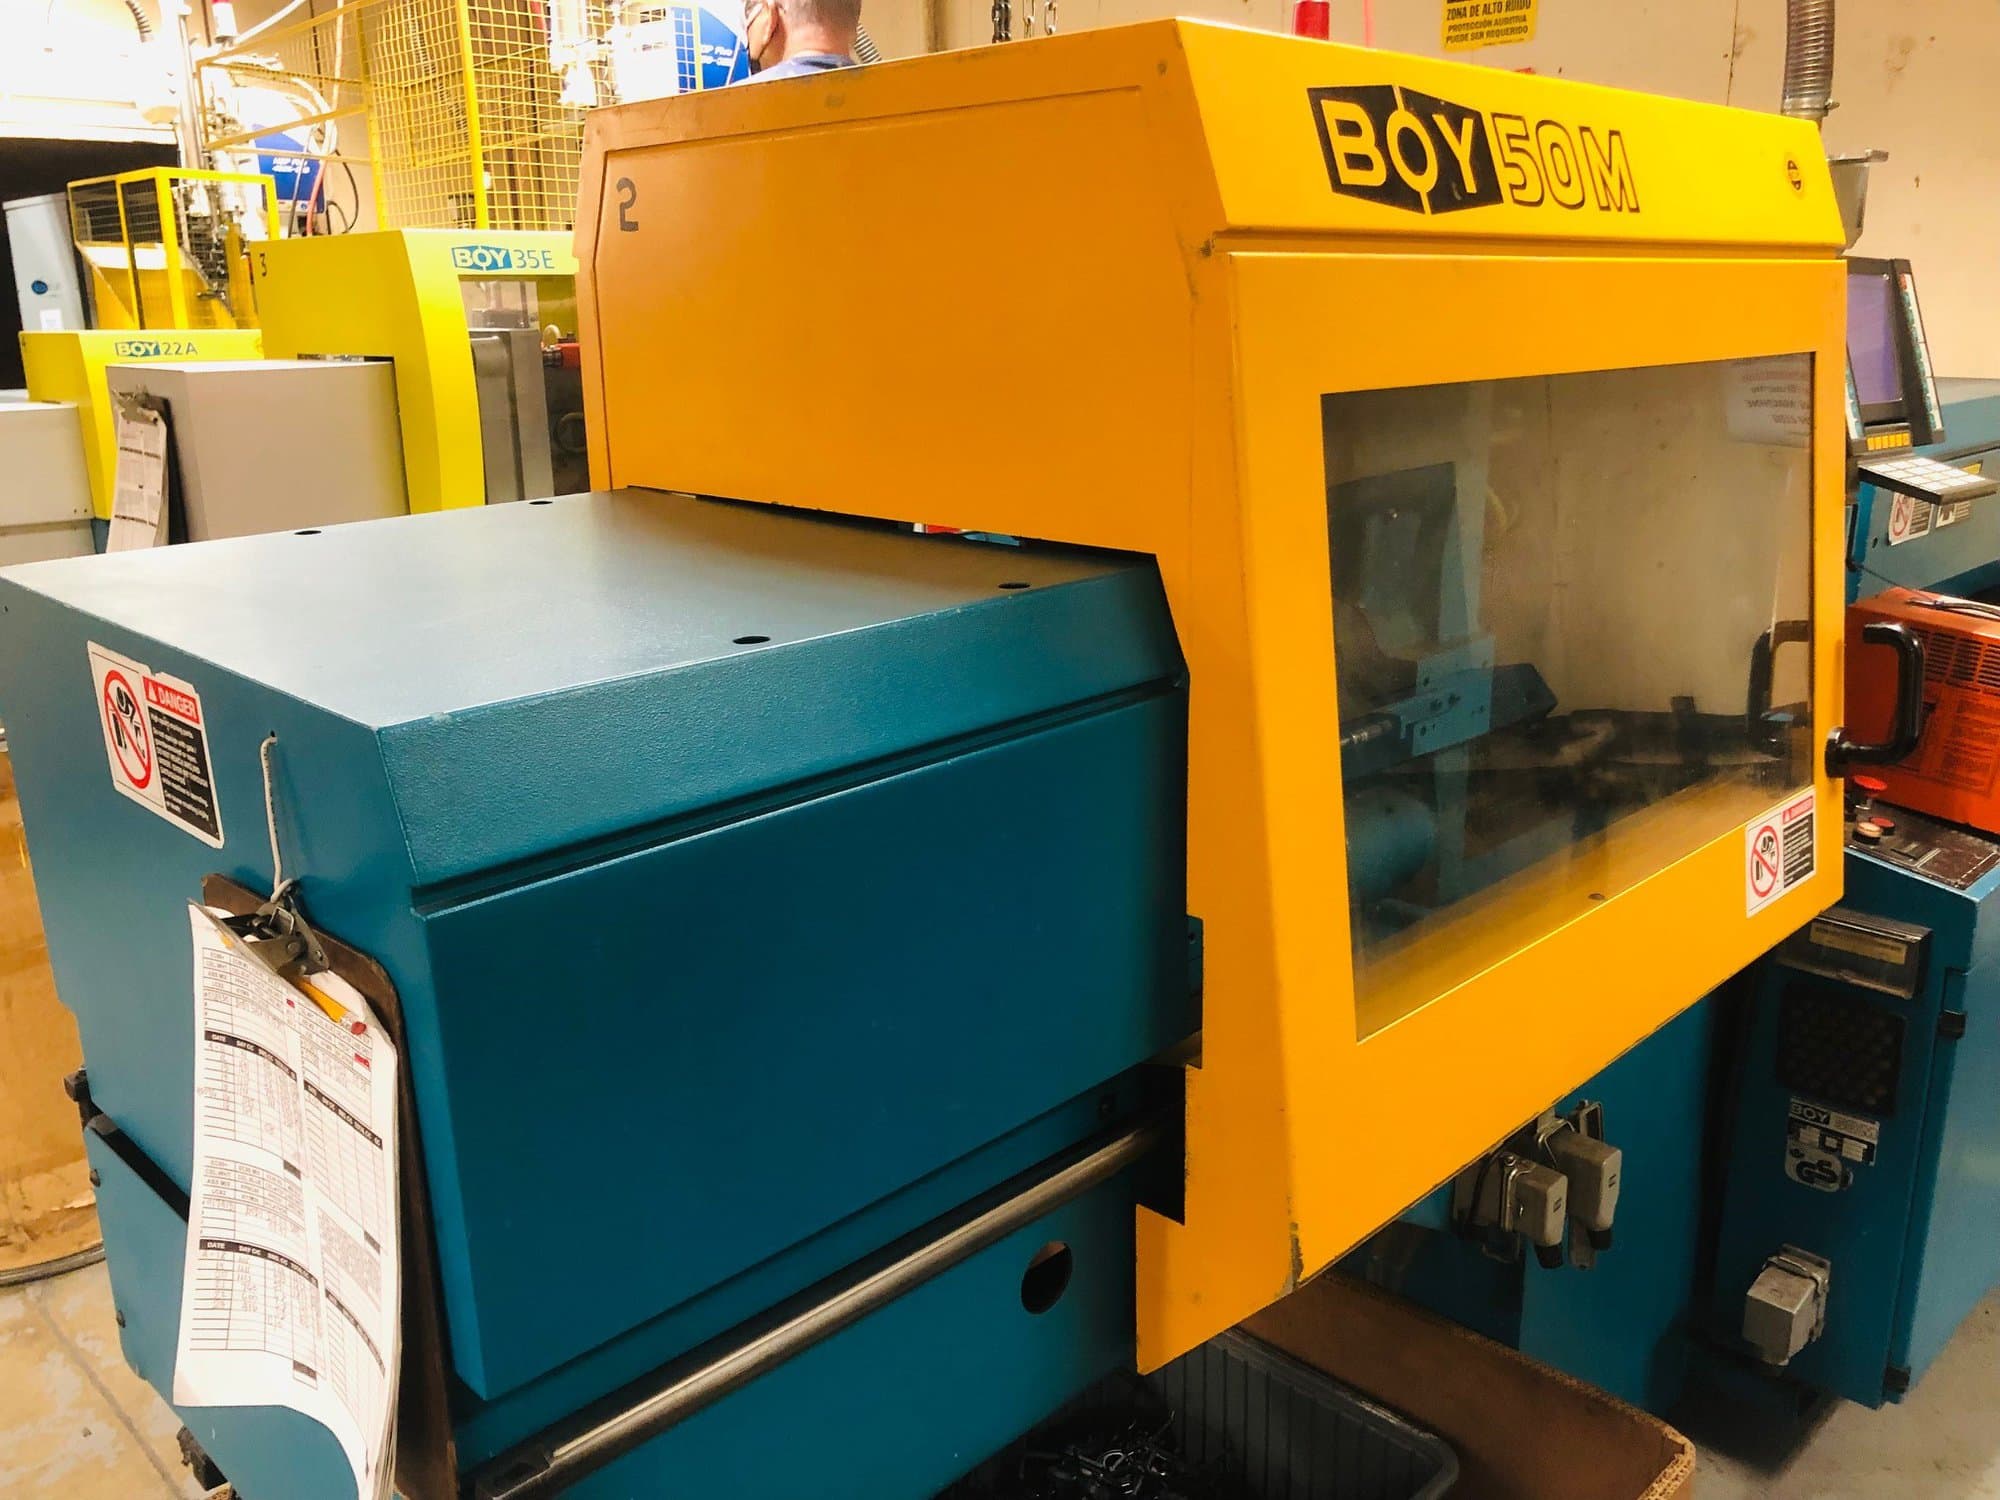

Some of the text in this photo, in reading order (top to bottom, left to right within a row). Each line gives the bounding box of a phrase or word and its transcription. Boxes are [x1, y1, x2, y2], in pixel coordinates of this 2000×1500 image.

[1447, 6, 1467, 21] ZONA
[1470, 4, 1480, 18] DE
[1482, 2, 1503, 16] ALTO
[1446, 33, 1469, 44] PUEDE
[1470, 31, 1484, 41] SER
[1486, 25, 1529, 39] REQUERIDO
[1317, 96, 1641, 214] BOY 50M
[616, 176, 639, 232] 2
[452, 247, 555, 269] BOY 35E
[116, 341, 198, 356] BOY 22A
[158, 686, 199, 721] DANGER
